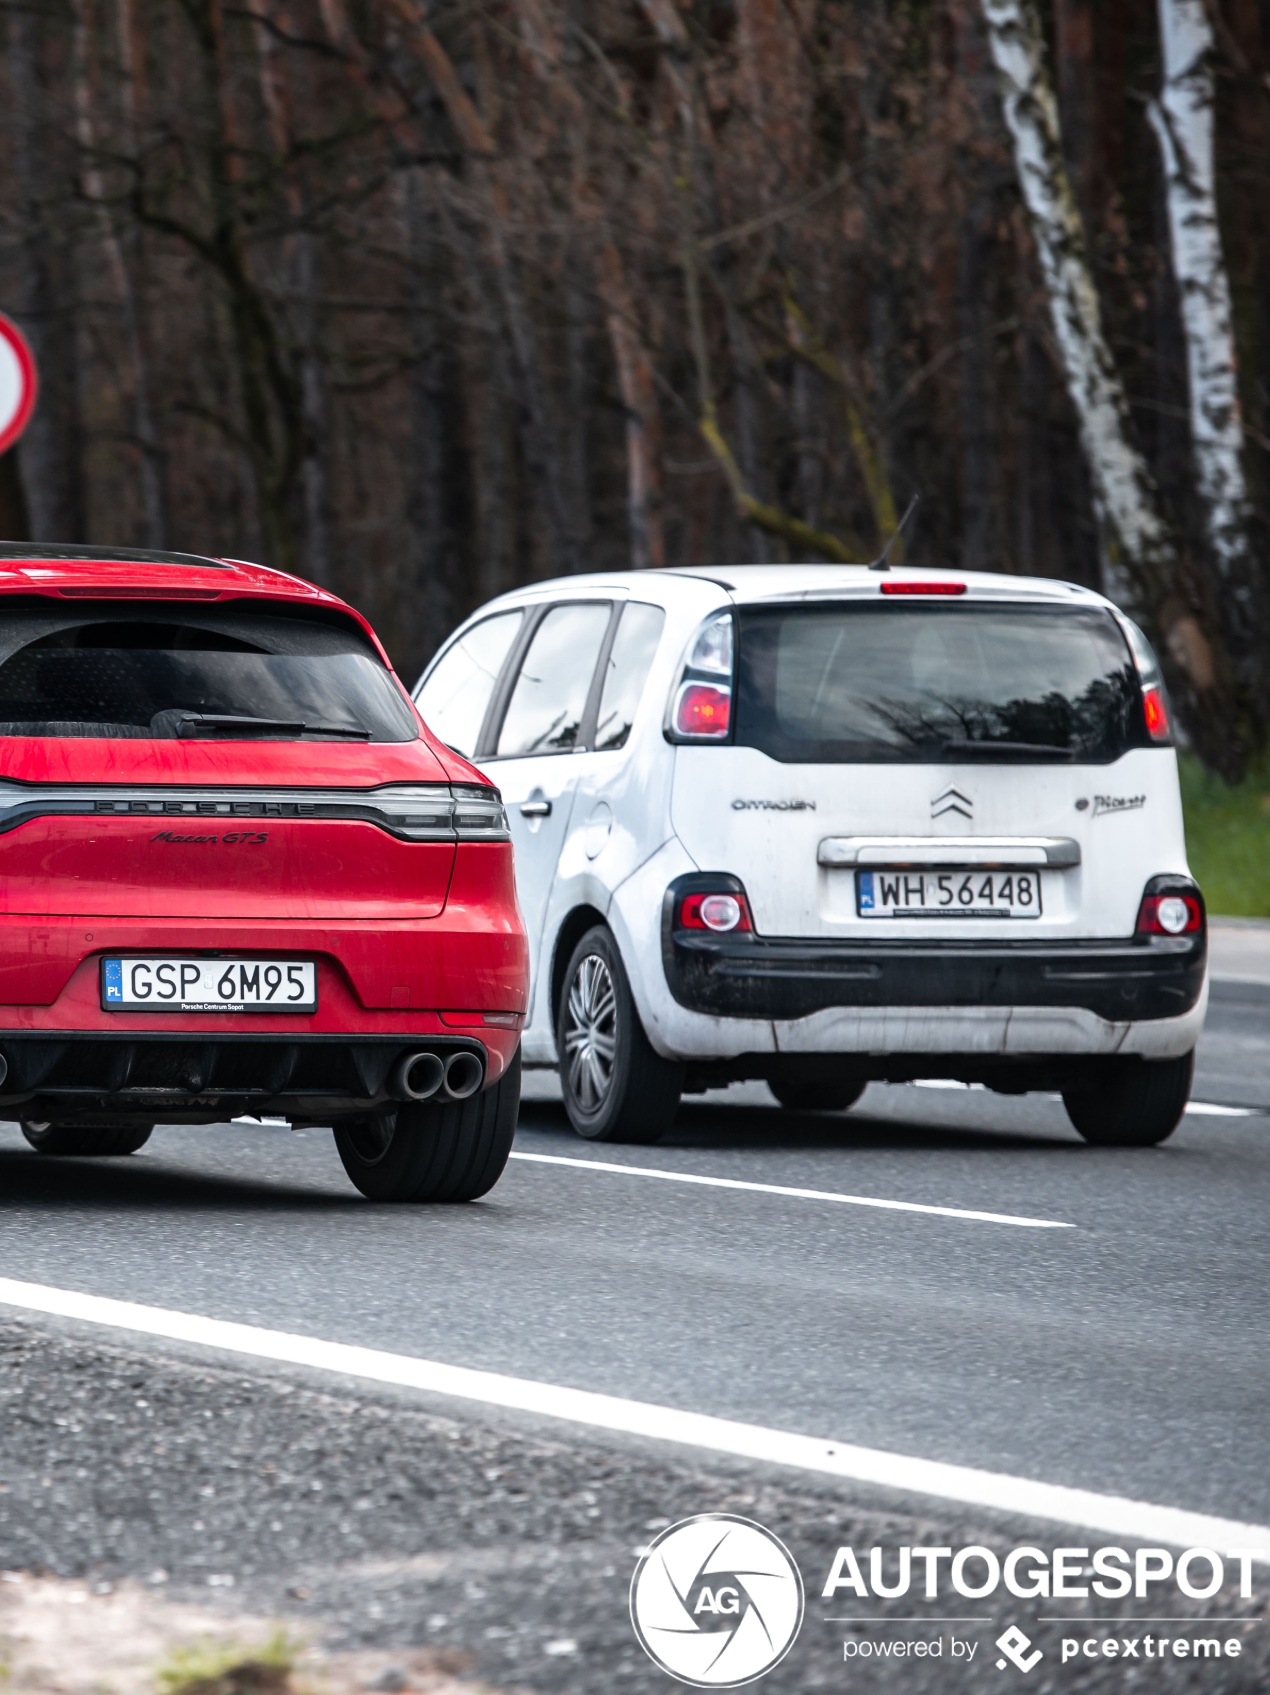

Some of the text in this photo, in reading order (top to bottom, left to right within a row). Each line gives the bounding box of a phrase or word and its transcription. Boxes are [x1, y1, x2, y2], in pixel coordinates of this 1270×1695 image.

[95, 800, 316, 815] PORSCHE
[150, 831, 269, 844] Macan GTS
[880, 875, 1033, 906] WH 56448
[131, 963, 305, 1001] GSP 6M95
[107, 986, 121, 997] PL
